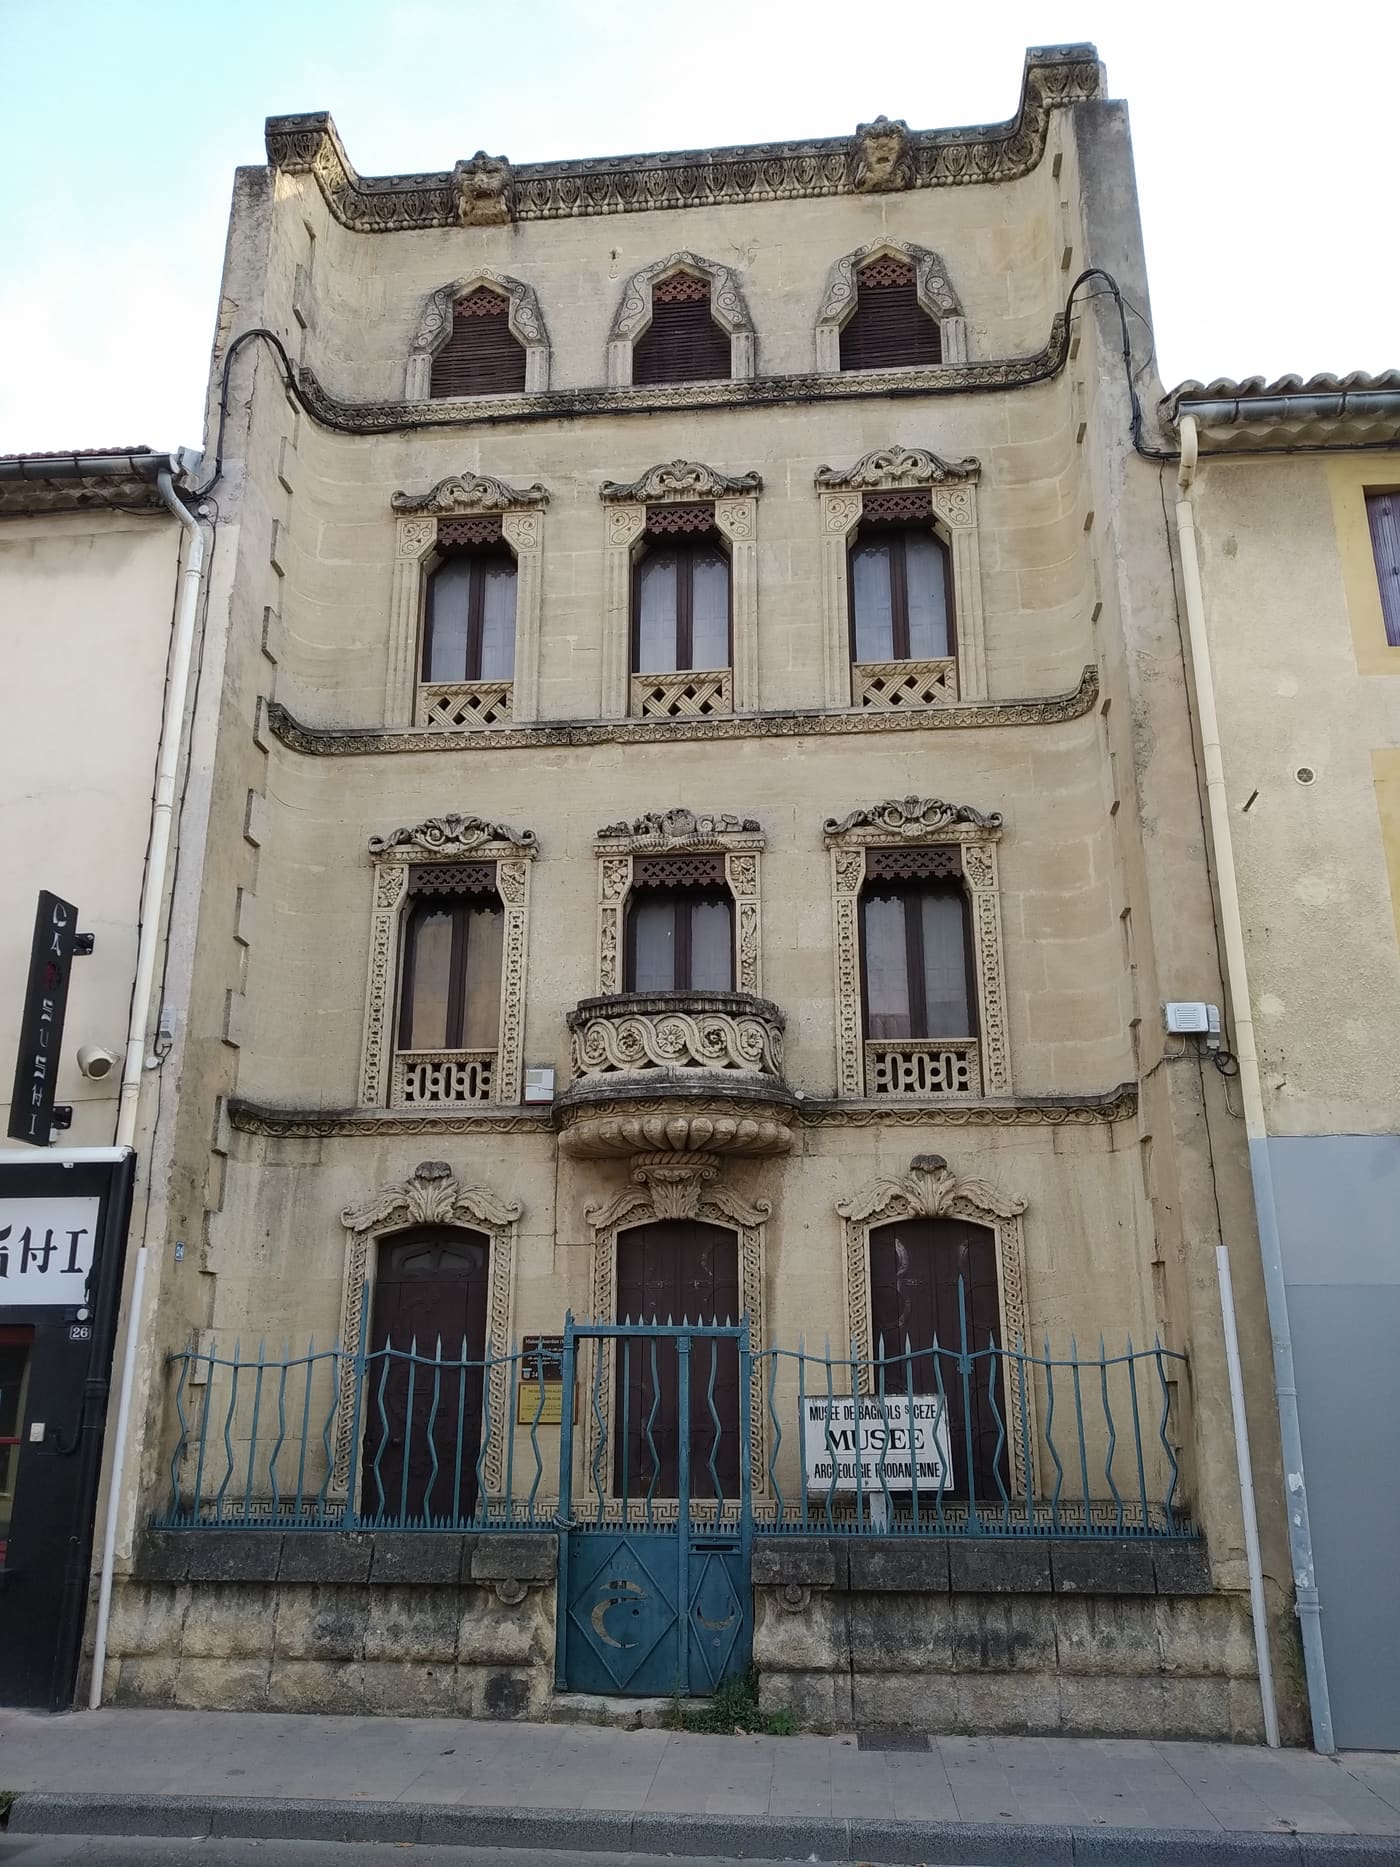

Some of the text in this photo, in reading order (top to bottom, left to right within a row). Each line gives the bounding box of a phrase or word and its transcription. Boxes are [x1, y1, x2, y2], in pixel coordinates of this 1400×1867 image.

[28, 998, 53, 1136] SUSHI
[72, 1326, 88, 1338] 26
[844, 1405, 855, 1420] DE
[913, 1404, 936, 1419] CEZE
[824, 1428, 925, 1451] MUSEE
[814, 1462, 940, 1478] ARCEOLOGIE RHODANENNE
